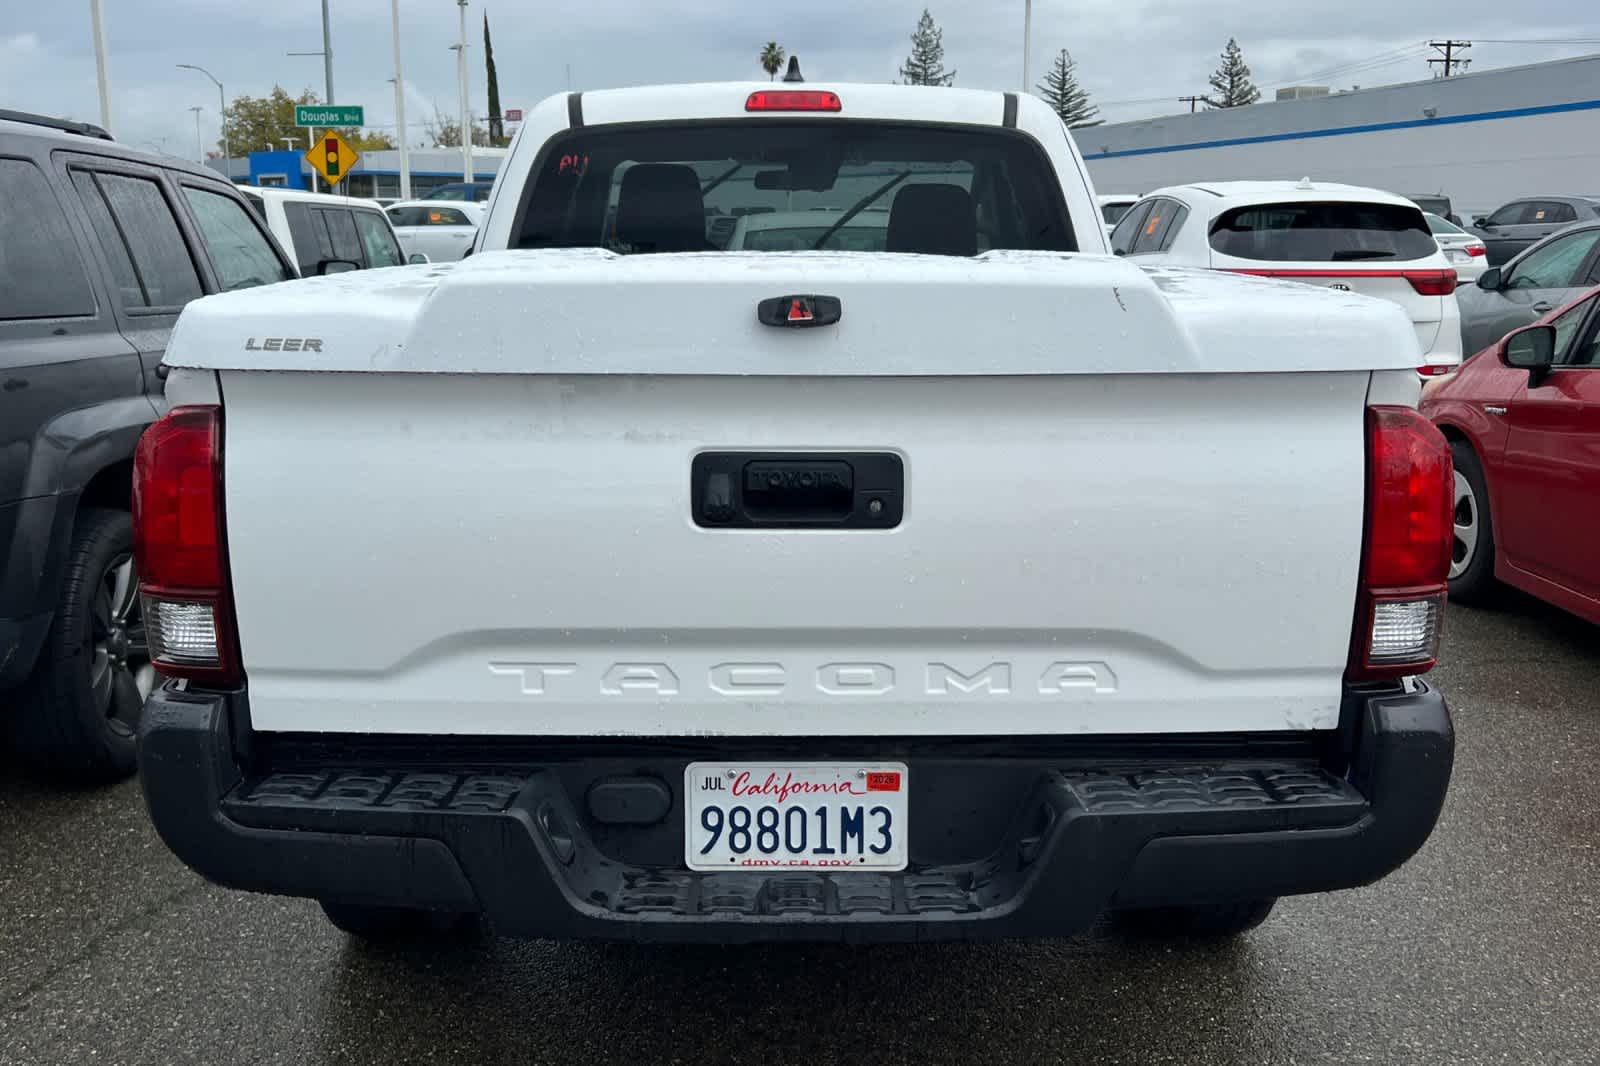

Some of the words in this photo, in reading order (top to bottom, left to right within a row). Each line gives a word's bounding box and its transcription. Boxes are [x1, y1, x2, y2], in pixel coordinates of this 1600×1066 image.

[300, 111, 339, 124] Douglas
[245, 338, 323, 352] LEER
[752, 471, 848, 488] TOYOTA
[488, 661, 1118, 696] TACOMA
[701, 777, 726, 790] JUL
[732, 772, 866, 803] California
[700, 806, 892, 854] 98801M3
[741, 858, 853, 867] dmv.ca.gov
